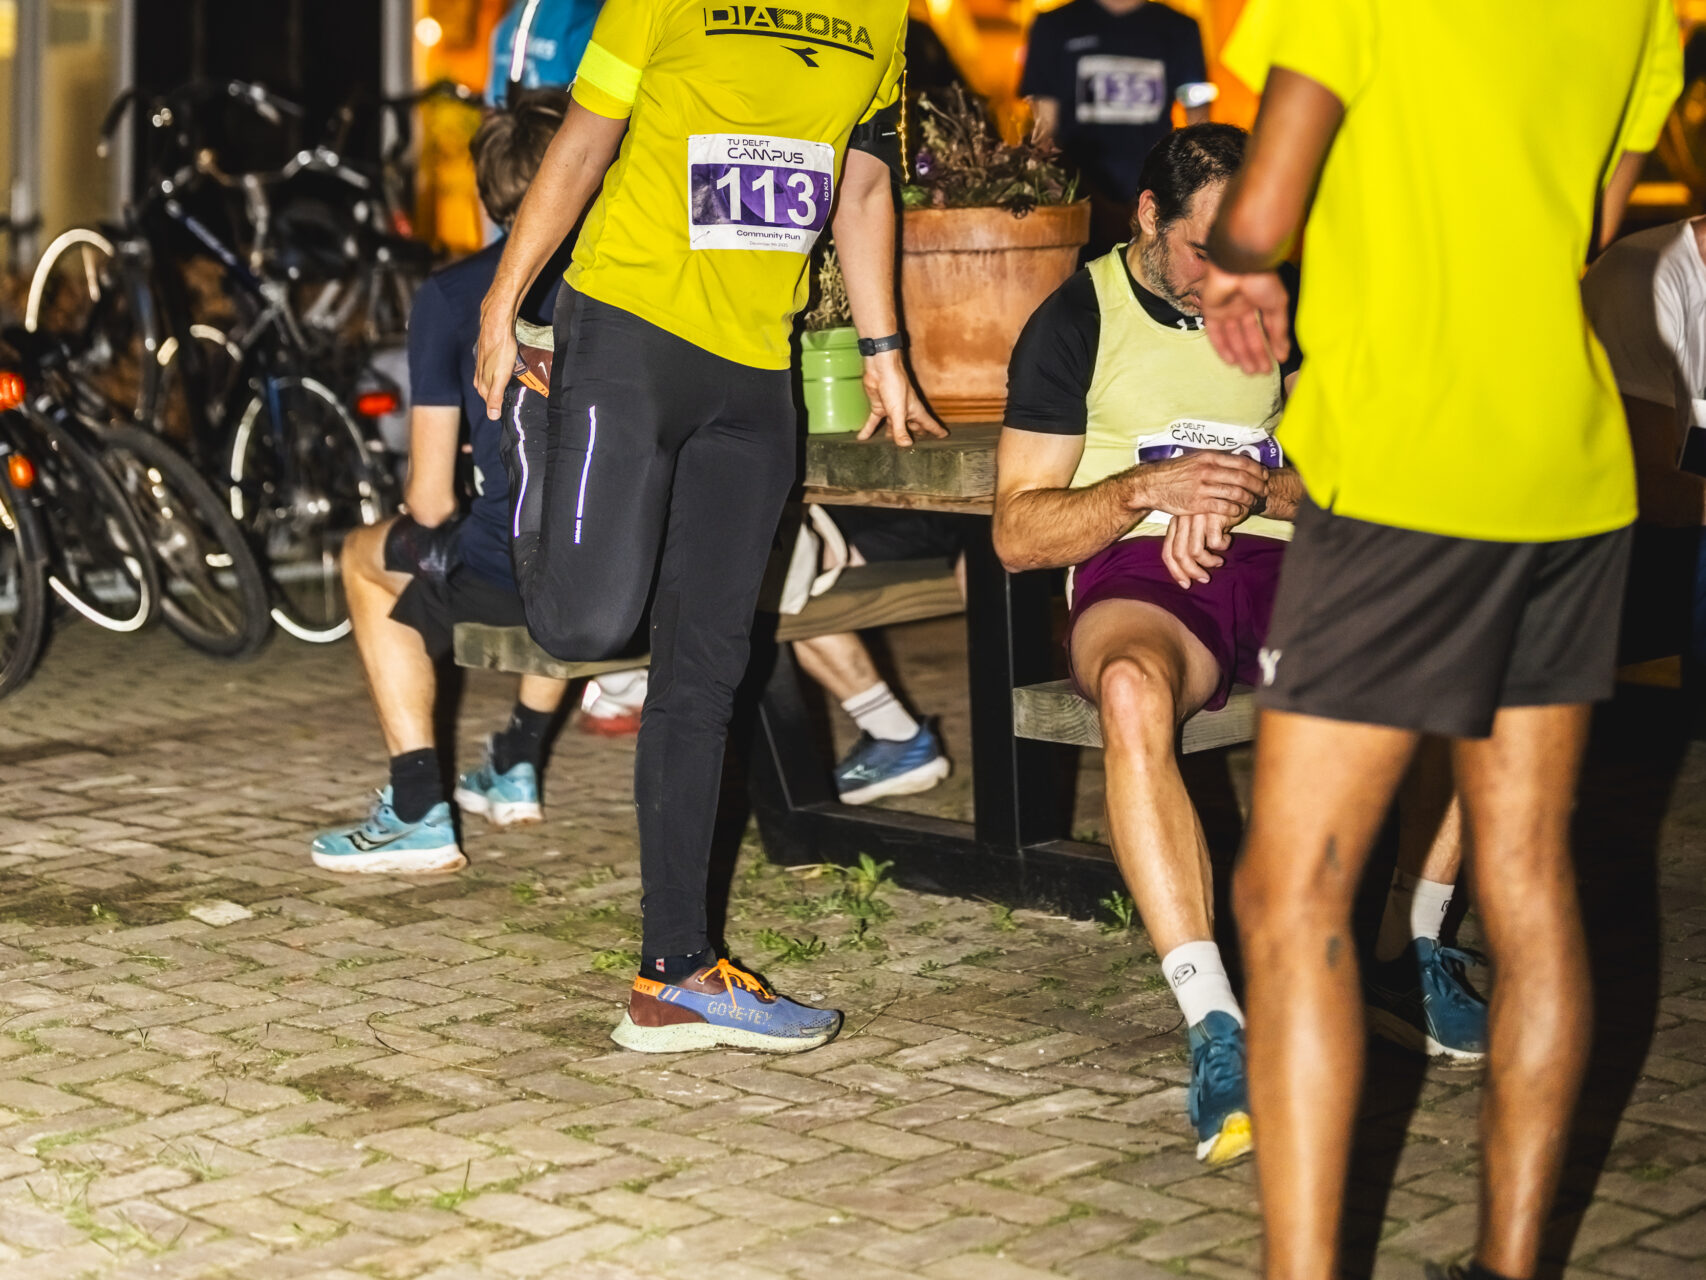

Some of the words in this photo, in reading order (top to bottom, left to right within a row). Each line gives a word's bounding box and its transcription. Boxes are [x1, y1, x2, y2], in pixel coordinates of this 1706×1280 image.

[703, 5, 874, 51] DIADORA
[727, 138, 740, 146] TU
[742, 139, 771, 148] DELFT
[727, 147, 805, 165] CAMPUS
[823, 176, 829, 190] KM
[716, 167, 817, 227] 113
[824, 191, 830, 202] 10
[736, 229, 784, 240] Community
[784, 233, 801, 241] Run
[1182, 422, 1206, 431] DELFT
[1171, 429, 1238, 447] CAMPUS
